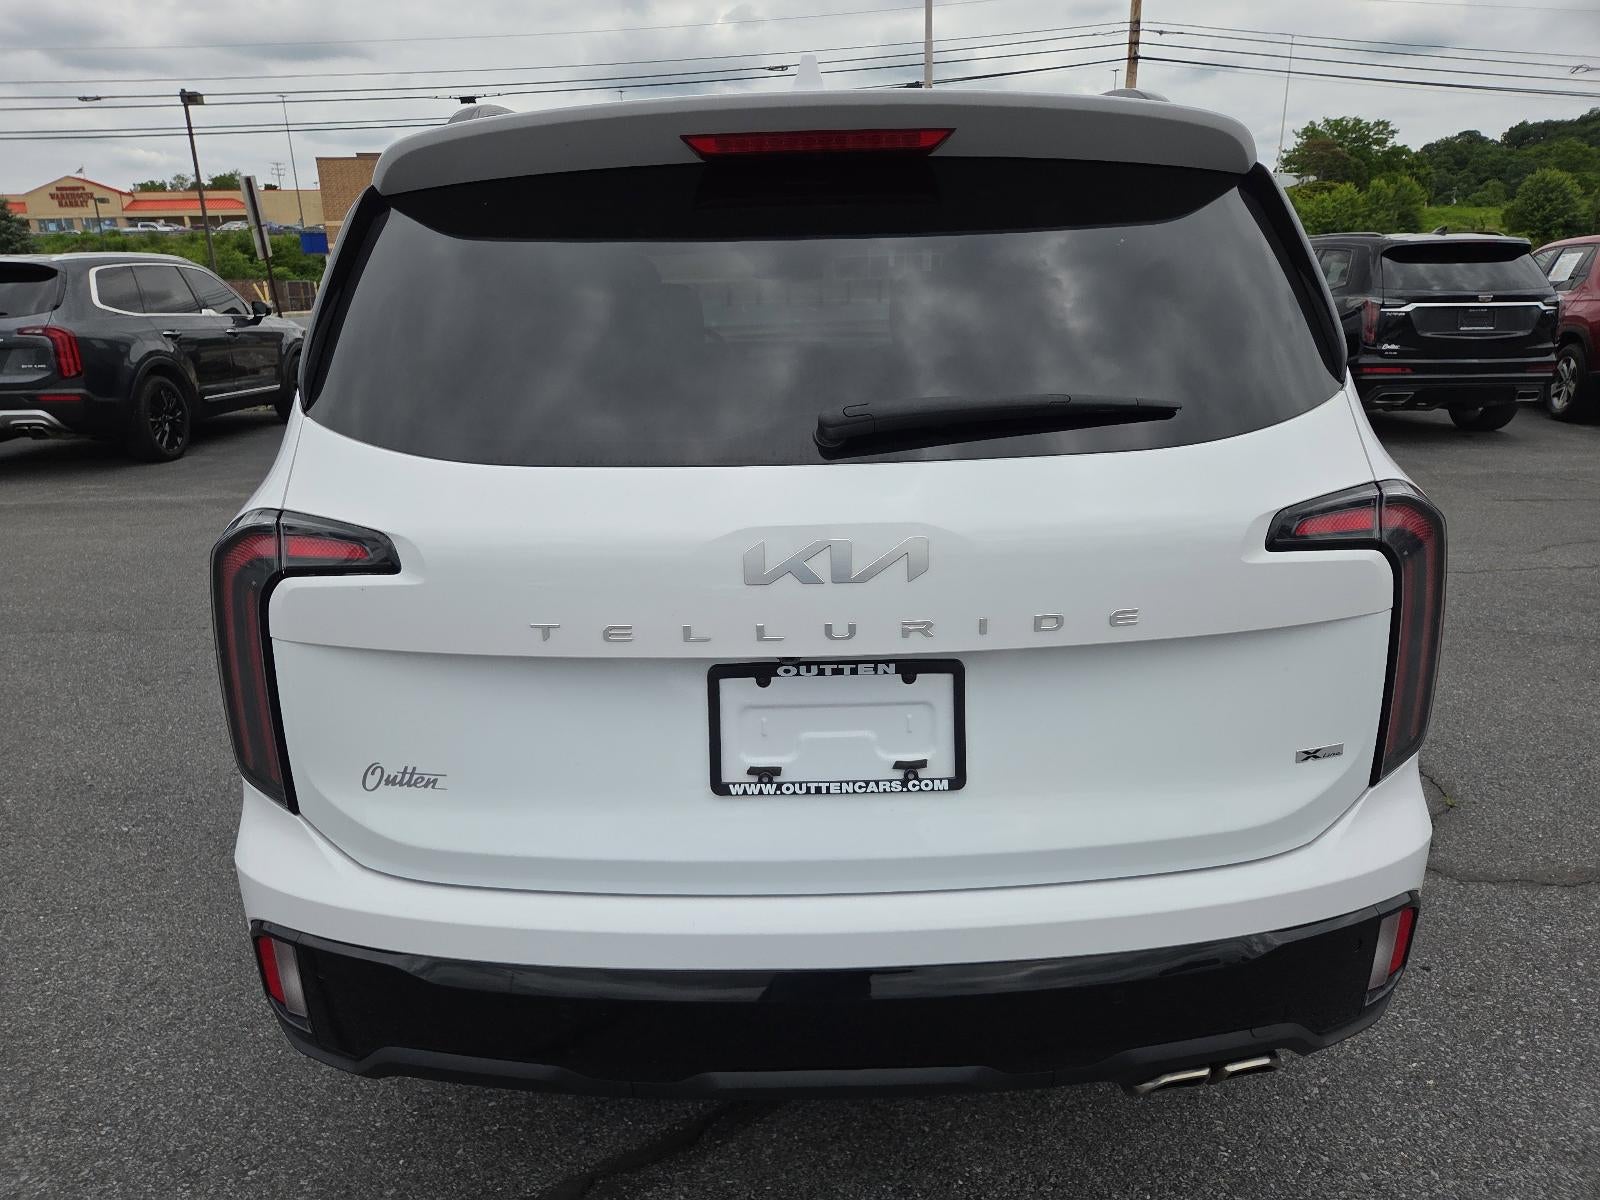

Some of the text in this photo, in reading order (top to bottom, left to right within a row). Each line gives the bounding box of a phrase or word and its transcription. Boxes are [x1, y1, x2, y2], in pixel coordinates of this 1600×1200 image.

[743, 535, 930, 585] KIA
[530, 607, 1140, 642] TELLURIDE
[776, 663, 896, 677] OUTTEN
[362, 762, 448, 792] Outten
[729, 779, 949, 795] WWW.OUTTENCARS.COM
